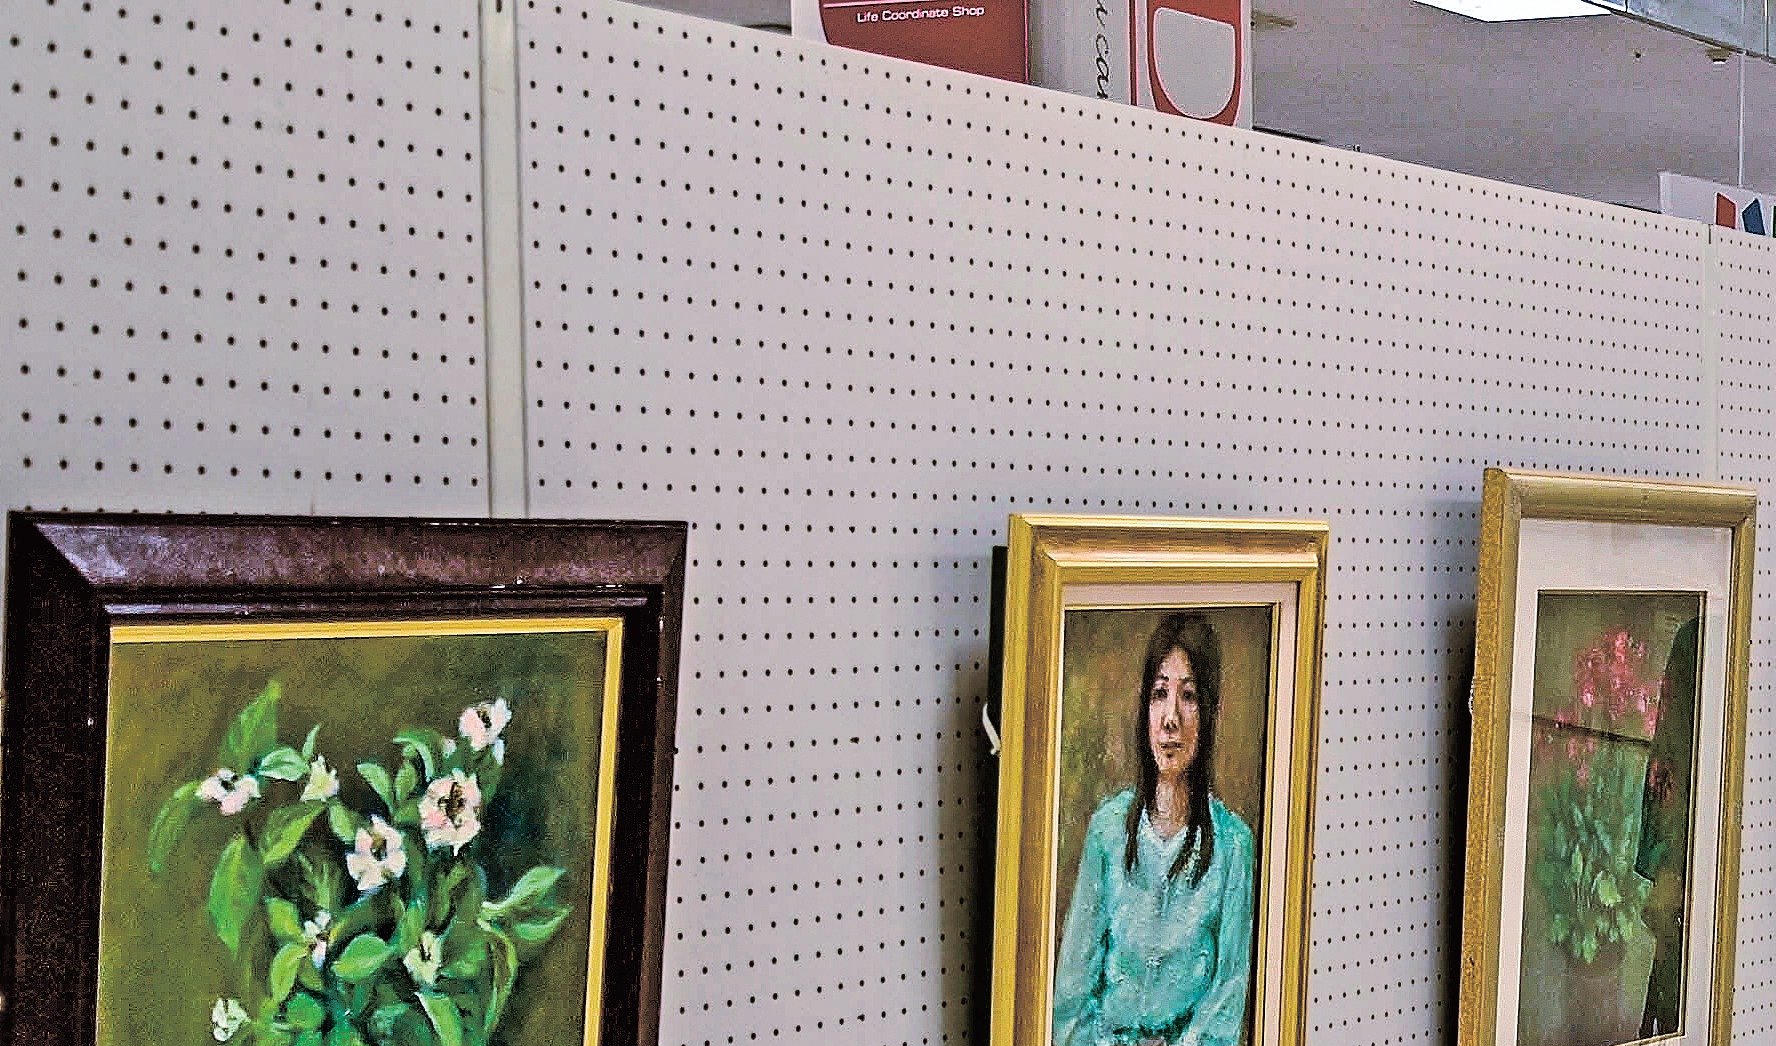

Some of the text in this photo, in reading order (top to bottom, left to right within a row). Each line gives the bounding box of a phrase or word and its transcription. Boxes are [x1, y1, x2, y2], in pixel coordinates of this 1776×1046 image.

[857, 6, 985, 23] Life Coordinate Shop
